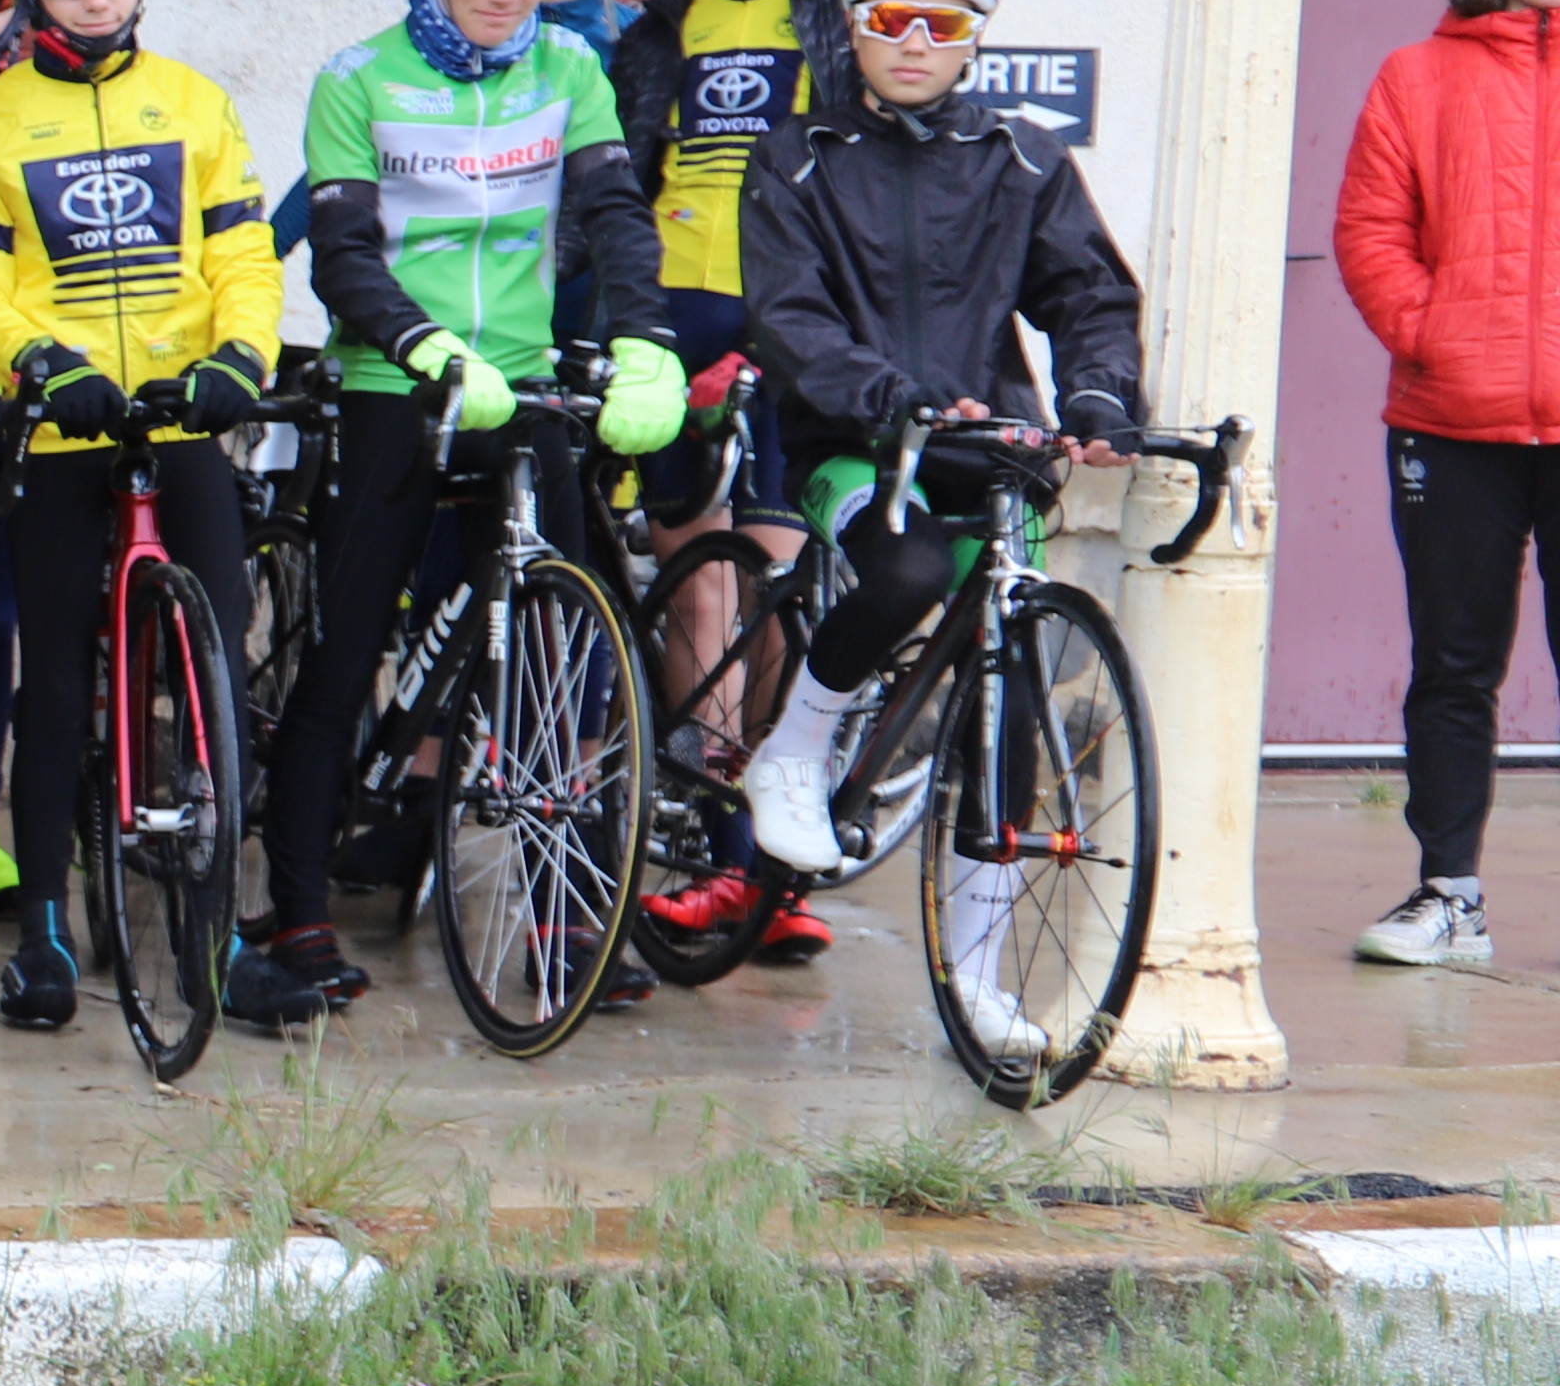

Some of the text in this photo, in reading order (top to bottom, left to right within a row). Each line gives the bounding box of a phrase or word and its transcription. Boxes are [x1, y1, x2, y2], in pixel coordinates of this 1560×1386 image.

[702, 53, 775, 70] Escudero
[696, 117, 770, 134] TOYOTA
[57, 153, 152, 177] Escudero
[68, 224, 158, 250] TOYOTA
[488, 600, 509, 661] BMC
[362, 750, 393, 792] BMC
